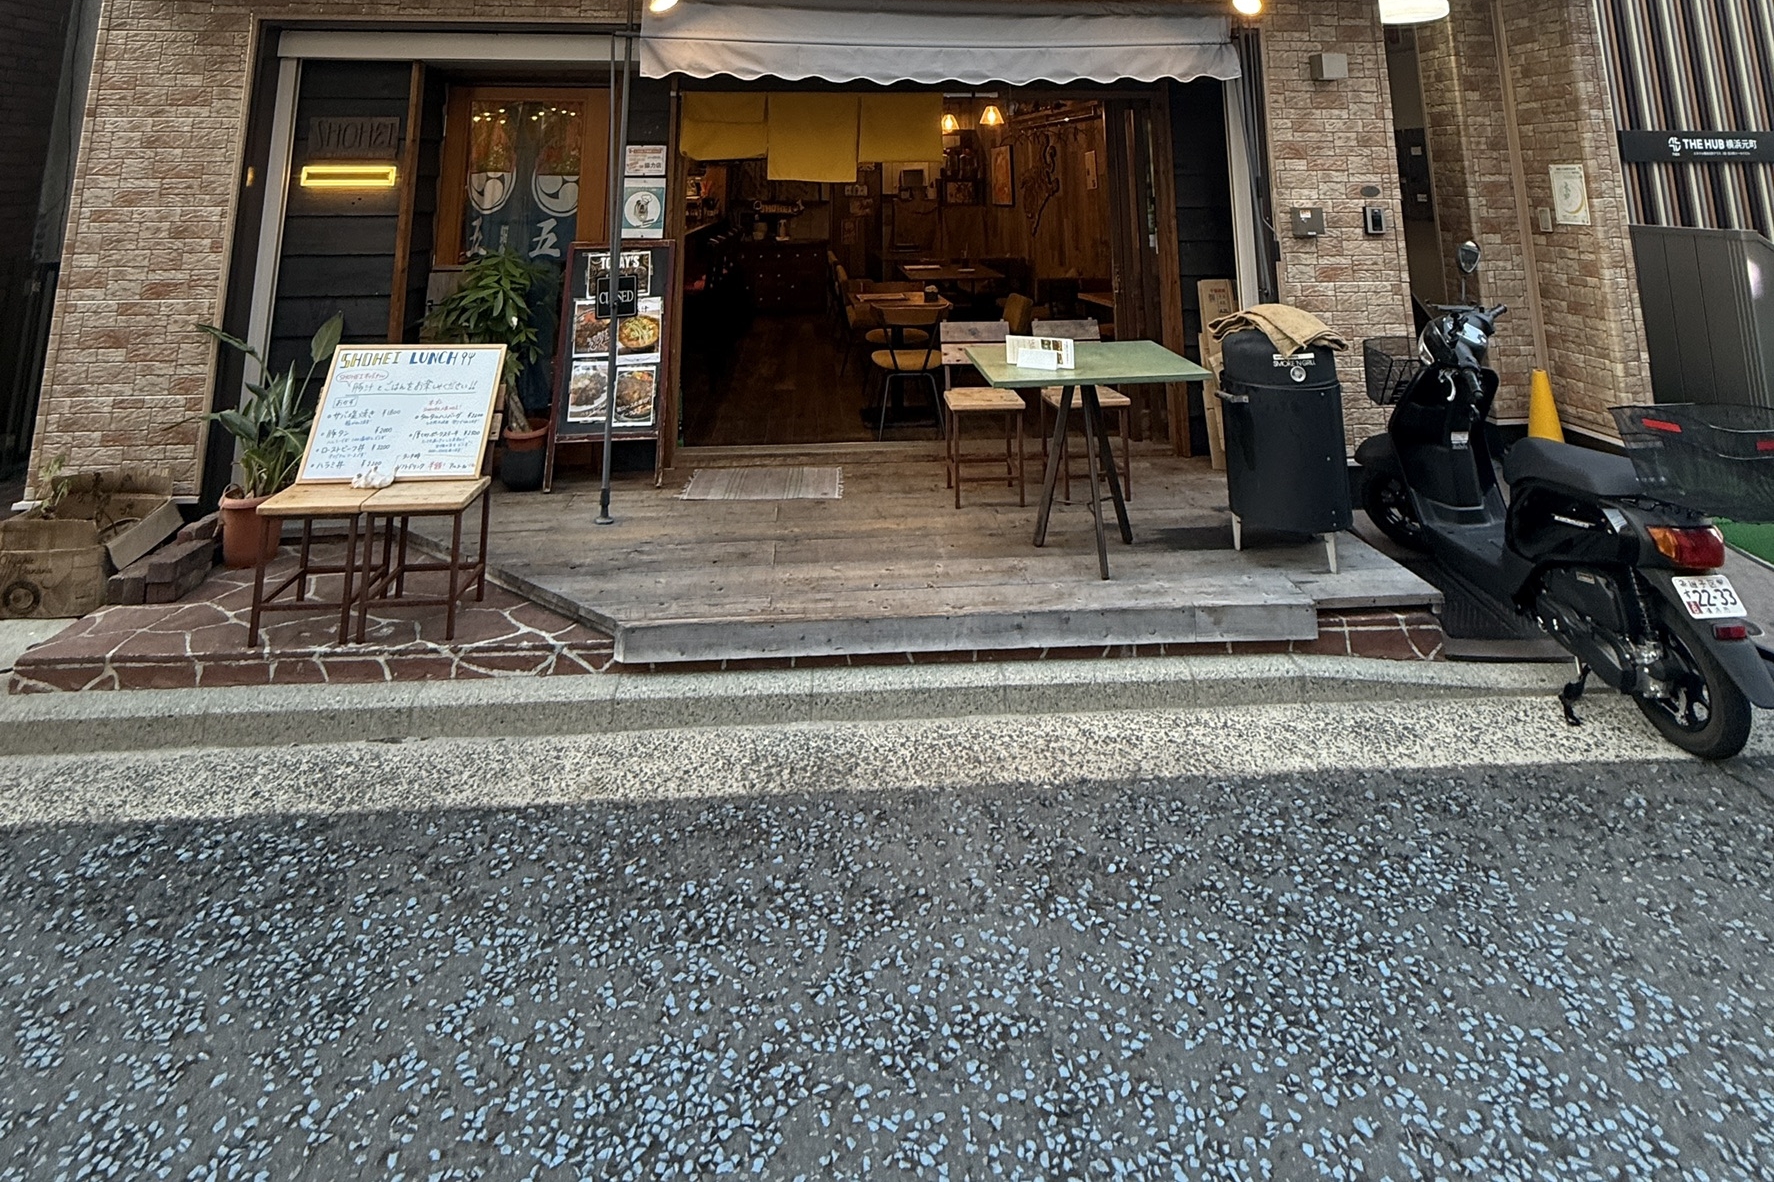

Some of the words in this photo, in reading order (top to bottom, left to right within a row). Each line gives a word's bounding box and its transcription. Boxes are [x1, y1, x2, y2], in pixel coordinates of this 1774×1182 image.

[1682, 138, 1703, 149] THE
[1705, 139, 1725, 149] HUB
[1726, 139, 1757, 150] 横浜元町
[528, 218, 561, 258] 五
[600, 255, 640, 270] TOAY'S
[599, 285, 634, 305] CLSED
[340, 351, 401, 369] SHOHEI
[409, 350, 458, 366] LUNCH
[1692, 588, 1738, 607] 22-33
